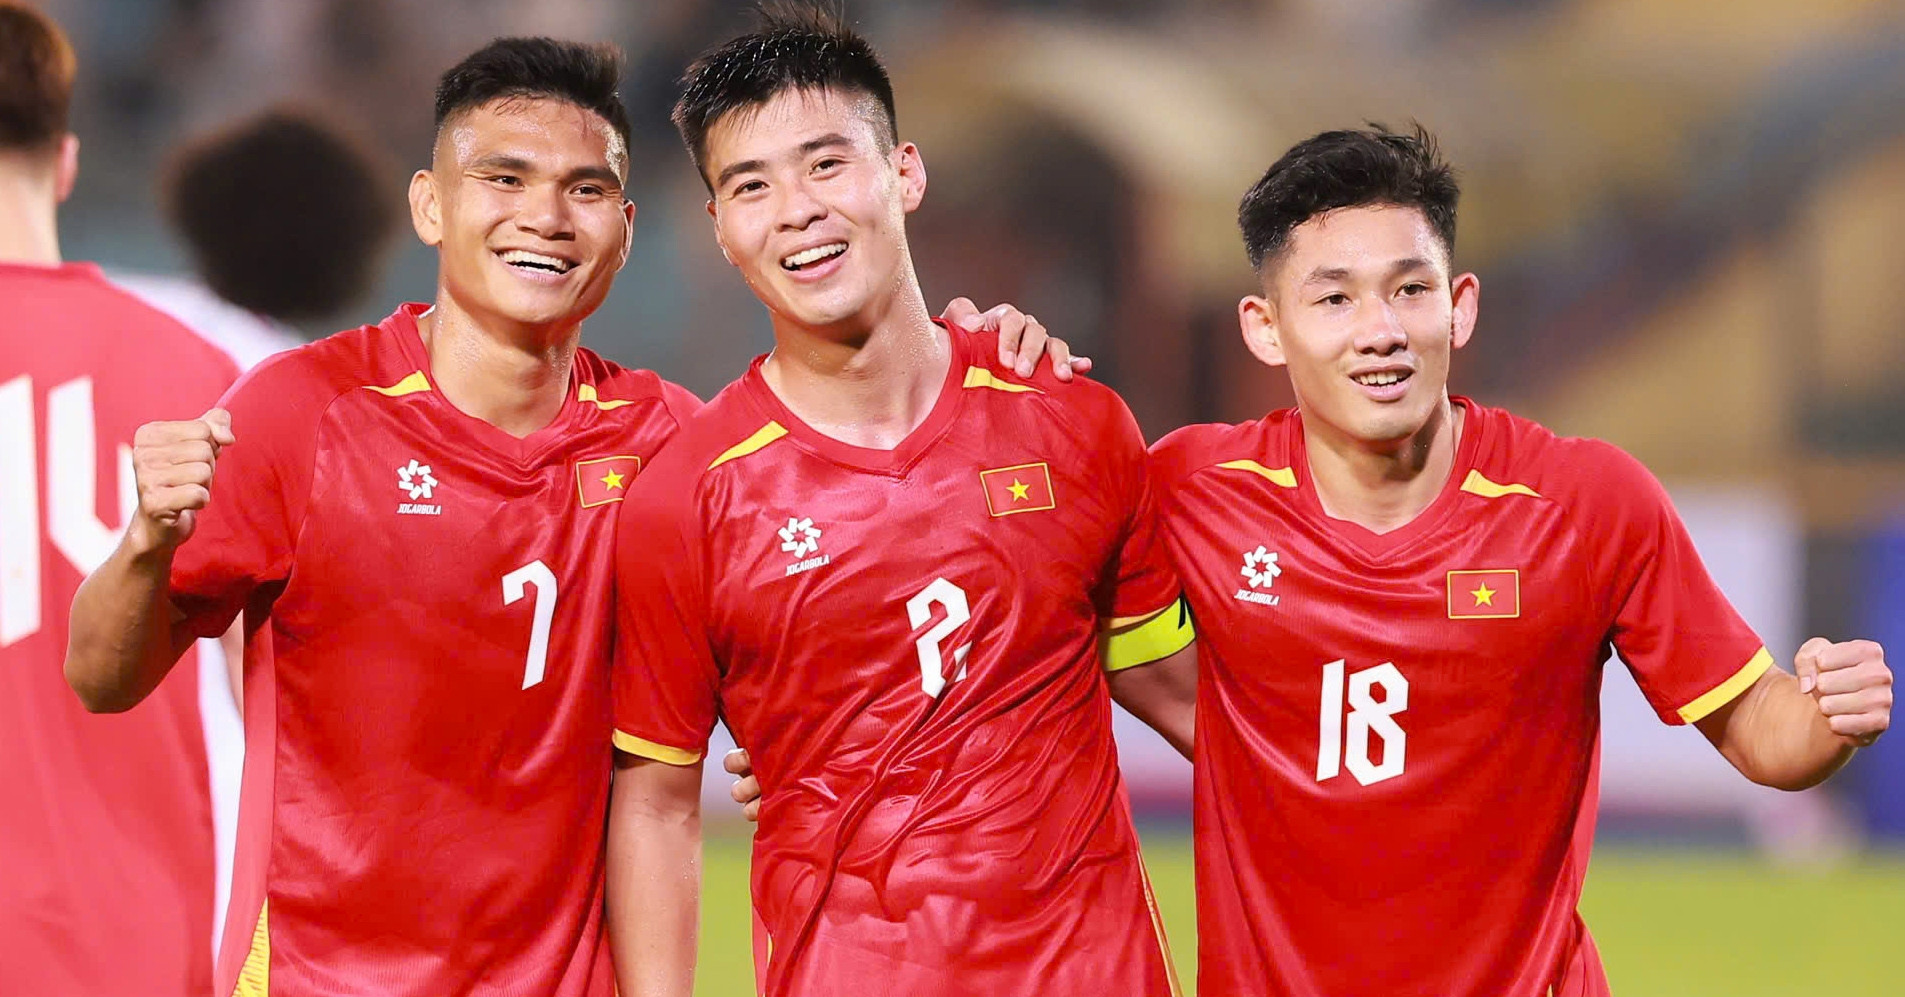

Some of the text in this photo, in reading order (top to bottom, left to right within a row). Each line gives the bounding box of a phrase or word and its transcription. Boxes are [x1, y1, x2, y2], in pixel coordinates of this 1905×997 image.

[501, 559, 558, 691] 7
[785, 554, 830, 577] JOGARBOLA
[905, 576, 973, 699] 2
[1315, 658, 1409, 787] 18
